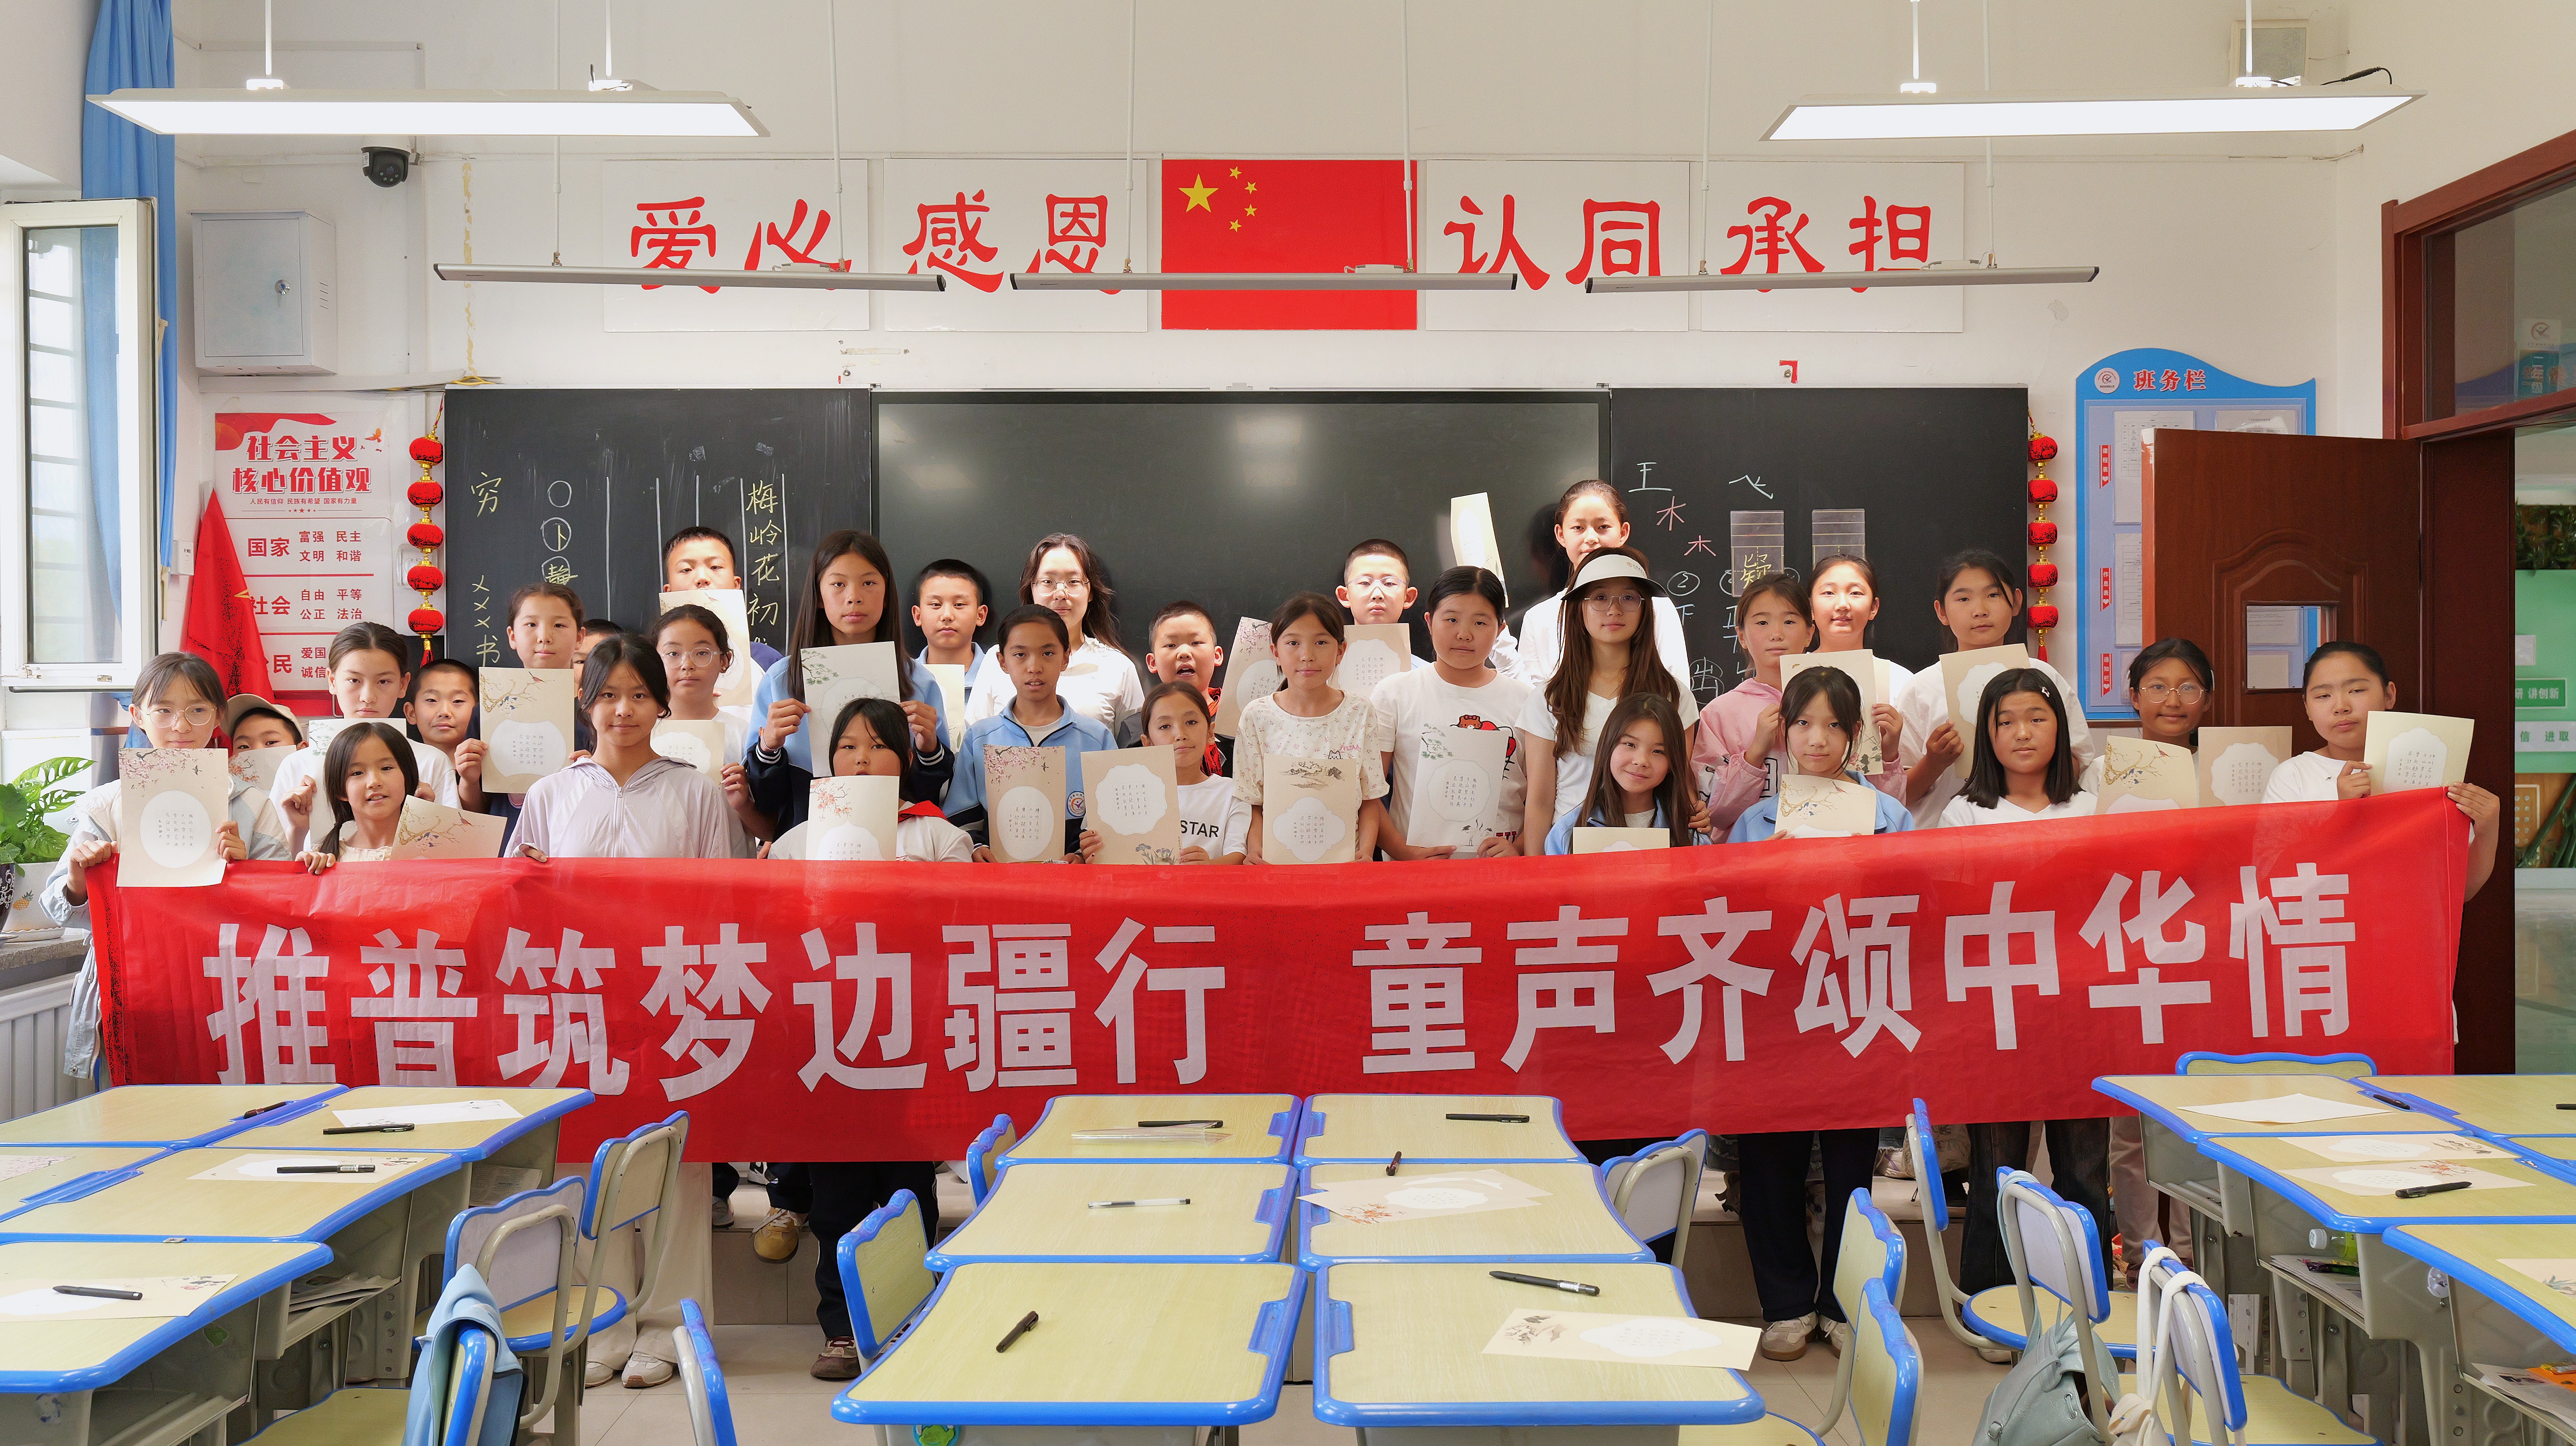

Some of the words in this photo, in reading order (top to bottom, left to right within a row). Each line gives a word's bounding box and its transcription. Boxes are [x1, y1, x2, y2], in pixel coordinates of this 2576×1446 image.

[630, 196, 852, 294] 爱心
[902, 189, 1123, 295] 感恩
[1443, 194, 1662, 291] 认同
[1720, 195, 1931, 294] 承担
[2133, 369, 2206, 392] 班务栏
[247, 434, 358, 462] 社会主义
[231, 466, 371, 494] 核心价值观
[248, 537, 290, 557] 国家
[299, 531, 325, 543] 富强
[336, 531, 361, 543] 民主
[299, 550, 325, 562] 文明
[336, 550, 362, 562] 和谐
[746, 480, 782, 645] 梅岭花初
[301, 589, 325, 601] 自由
[337, 588, 362, 601] 平等
[250, 595, 291, 616] 社会
[301, 608, 325, 620] 公正
[337, 608, 362, 620] 法治
[301, 647, 326, 659] 爱国
[265, 654, 292, 674] 民
[301, 666, 326, 678] 诚信
[1180, 820, 1219, 838] STAR
[202, 917, 1225, 1103] 推普筑梦边疆行
[1352, 862, 2356, 1075] 童声齐颂中华情
